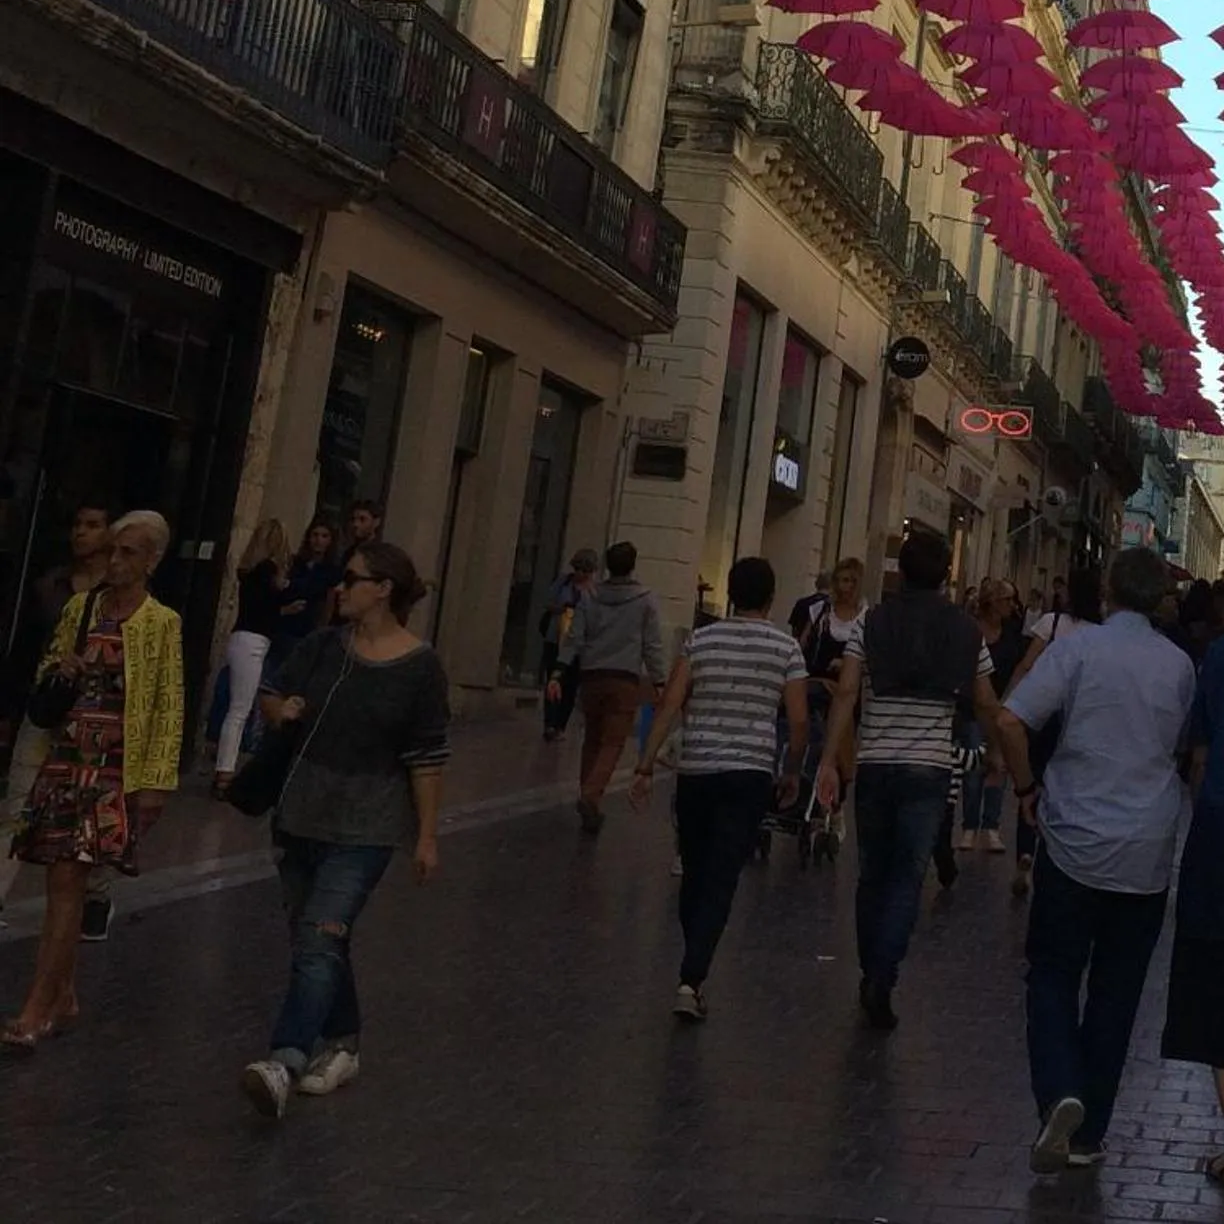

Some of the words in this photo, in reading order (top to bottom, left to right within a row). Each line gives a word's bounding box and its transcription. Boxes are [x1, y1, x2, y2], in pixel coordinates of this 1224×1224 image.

[54, 210, 139, 262] PHOTOGRAPHY
[144, 248, 183, 282] LIMITED
[184, 266, 223, 298] EDITION
